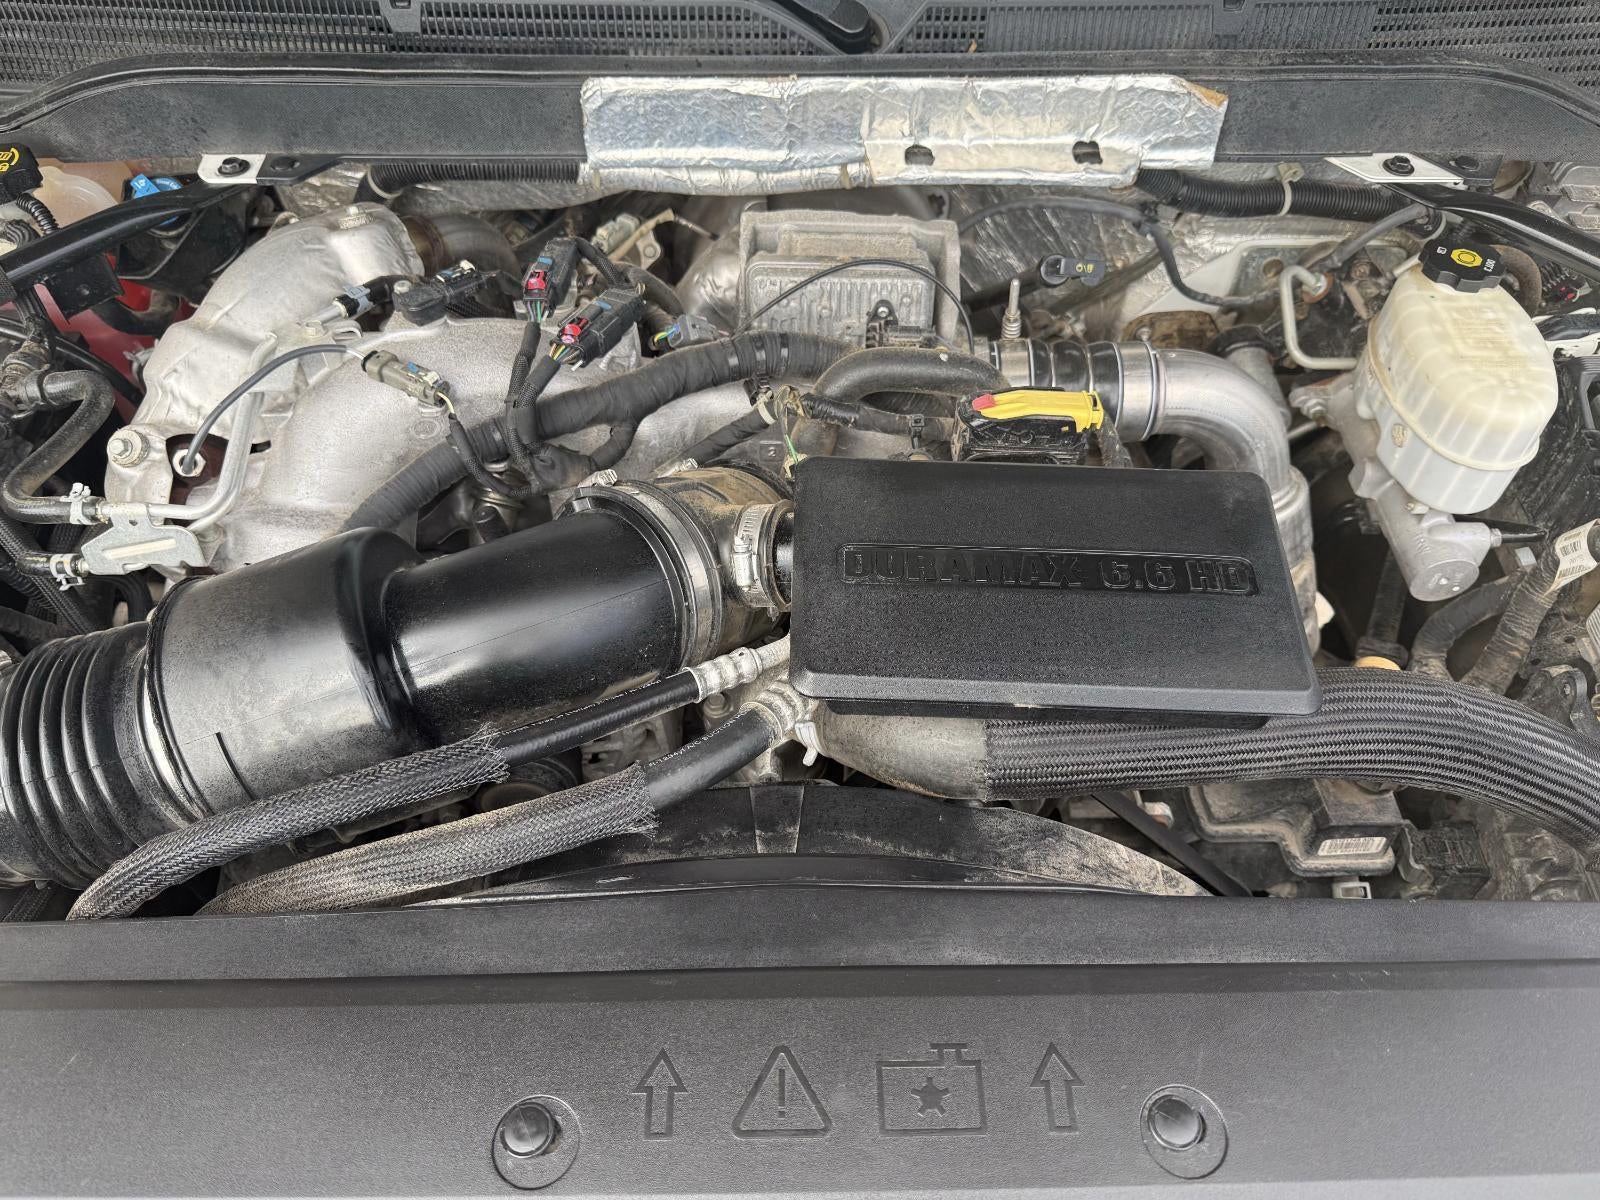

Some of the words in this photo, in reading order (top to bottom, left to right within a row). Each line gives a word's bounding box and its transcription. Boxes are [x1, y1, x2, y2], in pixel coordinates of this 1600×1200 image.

[843, 550, 1084, 586] DURAMAX
[1100, 556, 1177, 590] 6.6
[1185, 560, 1251, 593] HD
